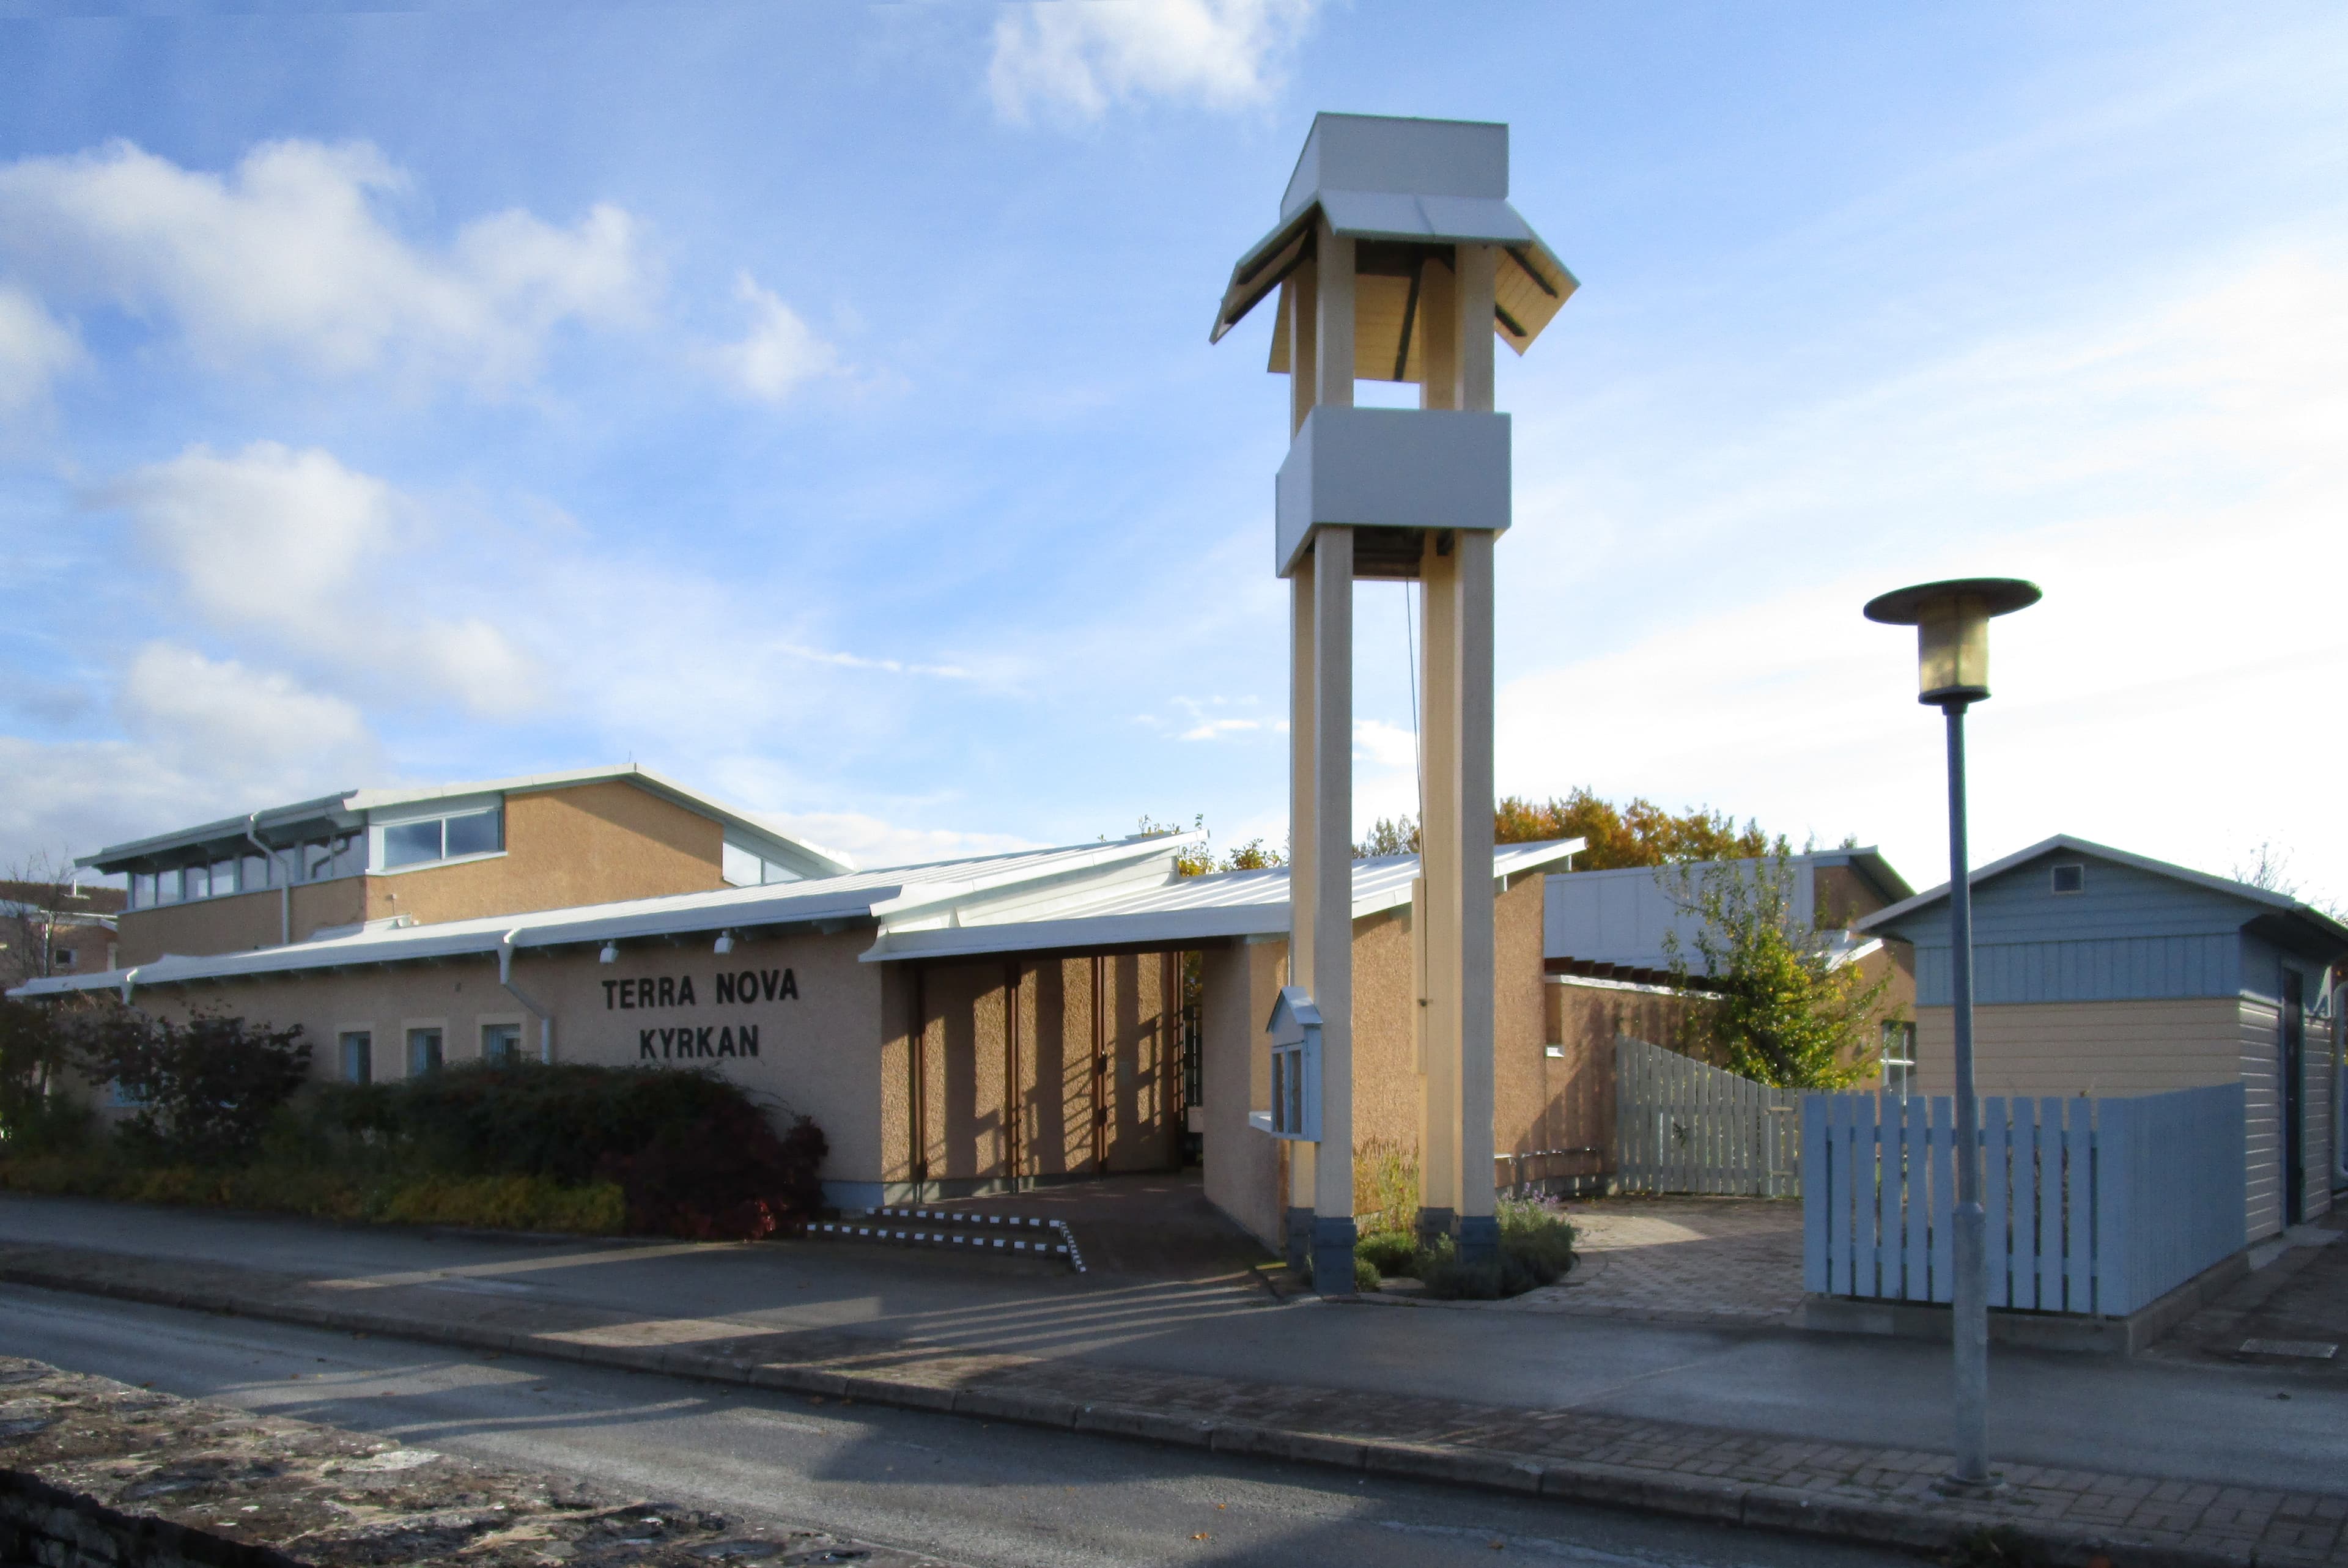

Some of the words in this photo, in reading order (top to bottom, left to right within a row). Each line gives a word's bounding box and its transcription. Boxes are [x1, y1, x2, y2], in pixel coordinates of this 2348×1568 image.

[602, 975, 695, 1010] TERRA
[716, 968, 799, 1004] NOVA
[640, 1024, 759, 1059] KYRKAN
